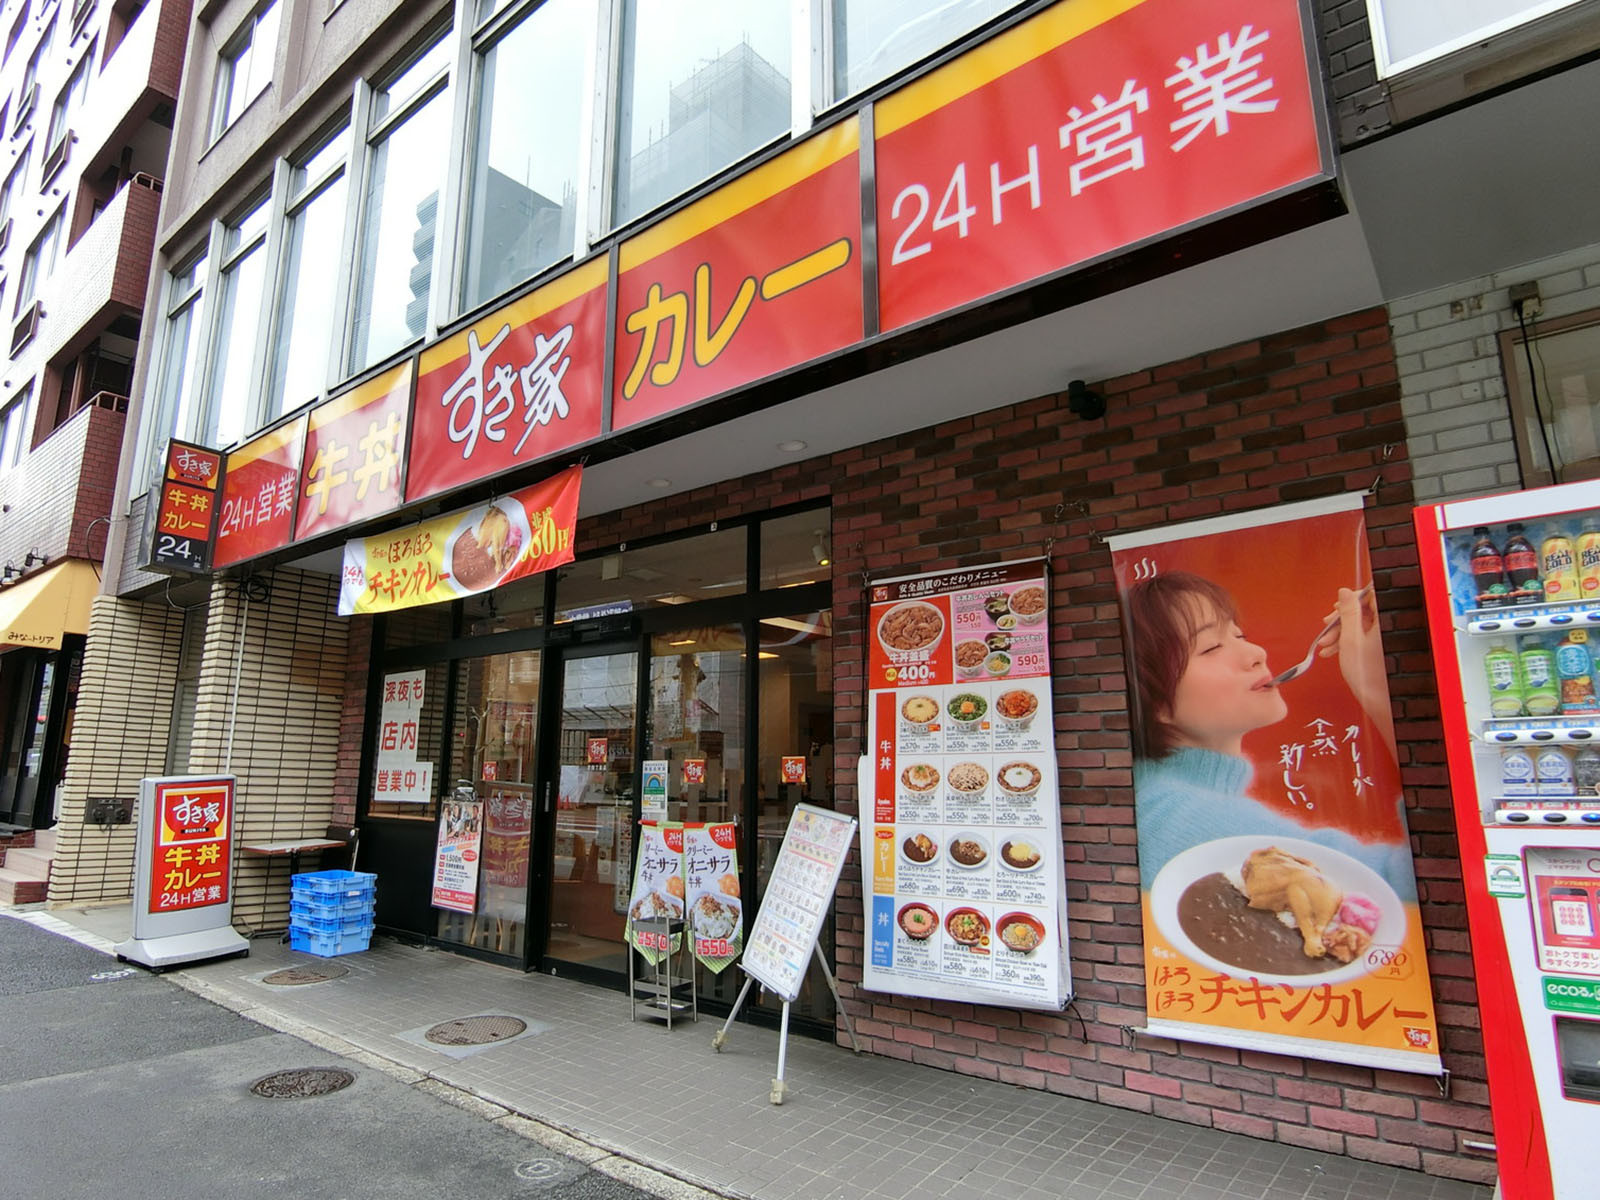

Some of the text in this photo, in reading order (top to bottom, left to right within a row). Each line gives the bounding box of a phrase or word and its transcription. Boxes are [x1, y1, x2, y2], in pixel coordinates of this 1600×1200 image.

[891, 24, 1280, 266] 24H営業
[622, 237, 852, 401] カレー
[442, 323, 574, 459] すき家
[176, 450, 213, 477] すき家
[305, 411, 401, 516] 牛丼
[168, 489, 209, 512] 牛丼
[219, 471, 296, 538] 24H営業
[163, 511, 206, 530] カレー
[367, 561, 450, 605] チキンカレー
[898, 569, 1009, 594] 安全品質のこだわりメニュー
[384, 678, 424, 703] 深夜も
[381, 719, 417, 751] 店内
[1304, 718, 1339, 758] 全然
[879, 739, 893, 771] 牛丼
[1342, 724, 1374, 797] カレーが
[377, 769, 428, 792] 営業中！
[172, 795, 220, 828] すき家
[164, 843, 221, 868] 牛丼
[688, 855, 731, 874] オニサラ
[163, 867, 222, 892] カレー
[688, 876, 702, 889] 牛丼
[159, 885, 222, 908] 24H営業
[1367, 948, 1408, 968] 680
[1153, 966, 1192, 987] ほろ
[1155, 990, 1195, 1013] ほろ
[1199, 972, 1428, 1032] チキンカレー
